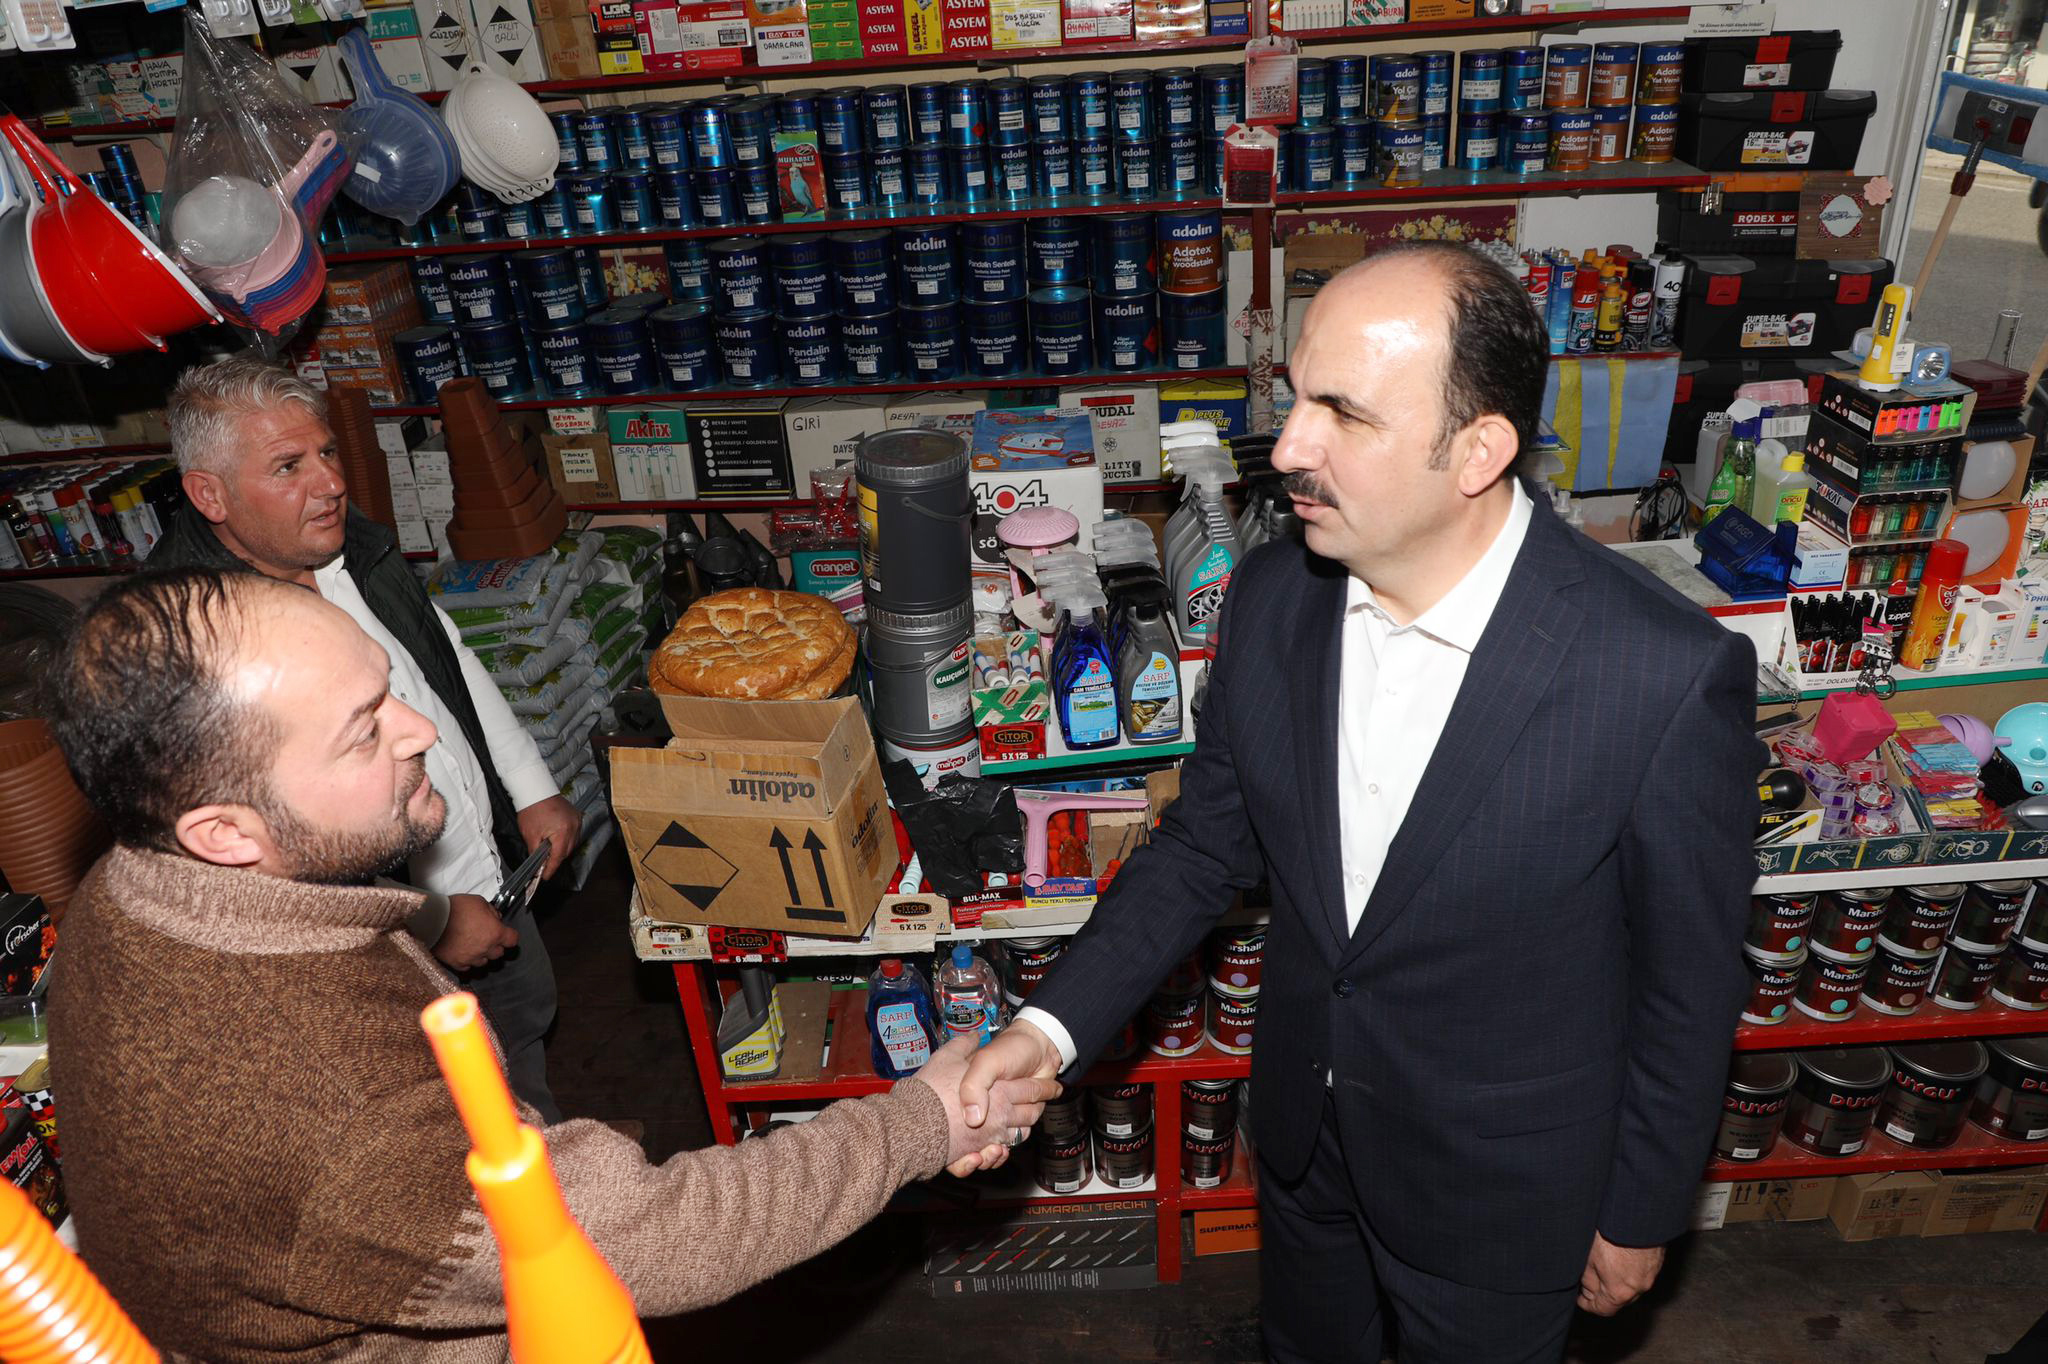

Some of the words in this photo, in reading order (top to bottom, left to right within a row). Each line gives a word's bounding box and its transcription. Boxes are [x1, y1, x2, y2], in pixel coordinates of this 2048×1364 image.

[866, 5, 895, 15] ASYEM
[948, 16, 987, 29] ASYEM
[767, 30, 805, 39] BAY-TEC
[867, 24, 896, 34] ASYEM
[870, 43, 899, 53] ASYEM
[950, 36, 989, 49] ASYEM
[1080, 85, 1106, 96] adolin
[1165, 81, 1193, 91] adolin
[1392, 86, 1405, 96] Yol
[1032, 89, 1060, 99] adolin
[1113, 87, 1141, 97] adolin
[870, 99, 897, 109] adolin
[578, 122, 604, 131] adolin
[1562, 119, 1591, 129] adolin
[1171, 139, 1197, 149] adolin
[1395, 135, 1423, 145] adolin
[1001, 148, 1028, 159] adolin
[1044, 146, 1069, 156] adolin
[1081, 144, 1108, 155] adolin
[1122, 147, 1150, 157] adolin
[875, 156, 901, 165] adolin
[1392, 152, 1405, 162] Yol
[1738, 214, 1775, 223] RODEX
[1172, 224, 1213, 237] adolin
[904, 238, 947, 251] adolin
[1173, 246, 1212, 258] Adotex
[719, 255, 758, 268] adolin
[1172, 258, 1214, 269] woodstain
[418, 266, 443, 276] adol
[451, 268, 488, 281] adolin
[720, 276, 762, 287] Pandalin
[1664, 281, 1681, 292] 40
[453, 288, 495, 300] Pandalin
[1105, 305, 1144, 317] adolin
[1746, 315, 1787, 323] SUPER-BAG
[719, 327, 751, 338] adolin
[787, 326, 826, 337] adolin
[843, 324, 878, 335] adolin
[542, 335, 580, 349] adolin
[415, 342, 451, 357] adolin
[788, 345, 830, 357] Pandalin
[544, 354, 586, 368] Pandalin
[1196, 410, 1224, 419] PLUS
[626, 419, 672, 438] Akfix
[1097, 418, 1128, 430] EYAZ
[970, 479, 1048, 514] 404
[1816, 480, 1844, 506] TOKAI
[14, 520, 33, 532] CAS
[811, 560, 856, 573] manpet
[1081, 674, 1108, 685] SARP
[1144, 671, 1171, 683] SARP
[1015, 752, 1029, 760] 125
[937, 757, 966, 769] manpet
[729, 778, 816, 803] adolin
[962, 892, 1001, 903] BUL-MAX
[899, 923, 905, 931] 6
[913, 923, 927, 931] 125
[880, 1011, 912, 1024] SARP
[882, 1025, 892, 1040] 4
[735, 1050, 769, 1069] REPAIR
[1103, 1138, 1149, 1153] DUYGU
[1186, 1138, 1232, 1154] DUYGU
[1199, 1221, 1260, 1235] SUPERMAX
